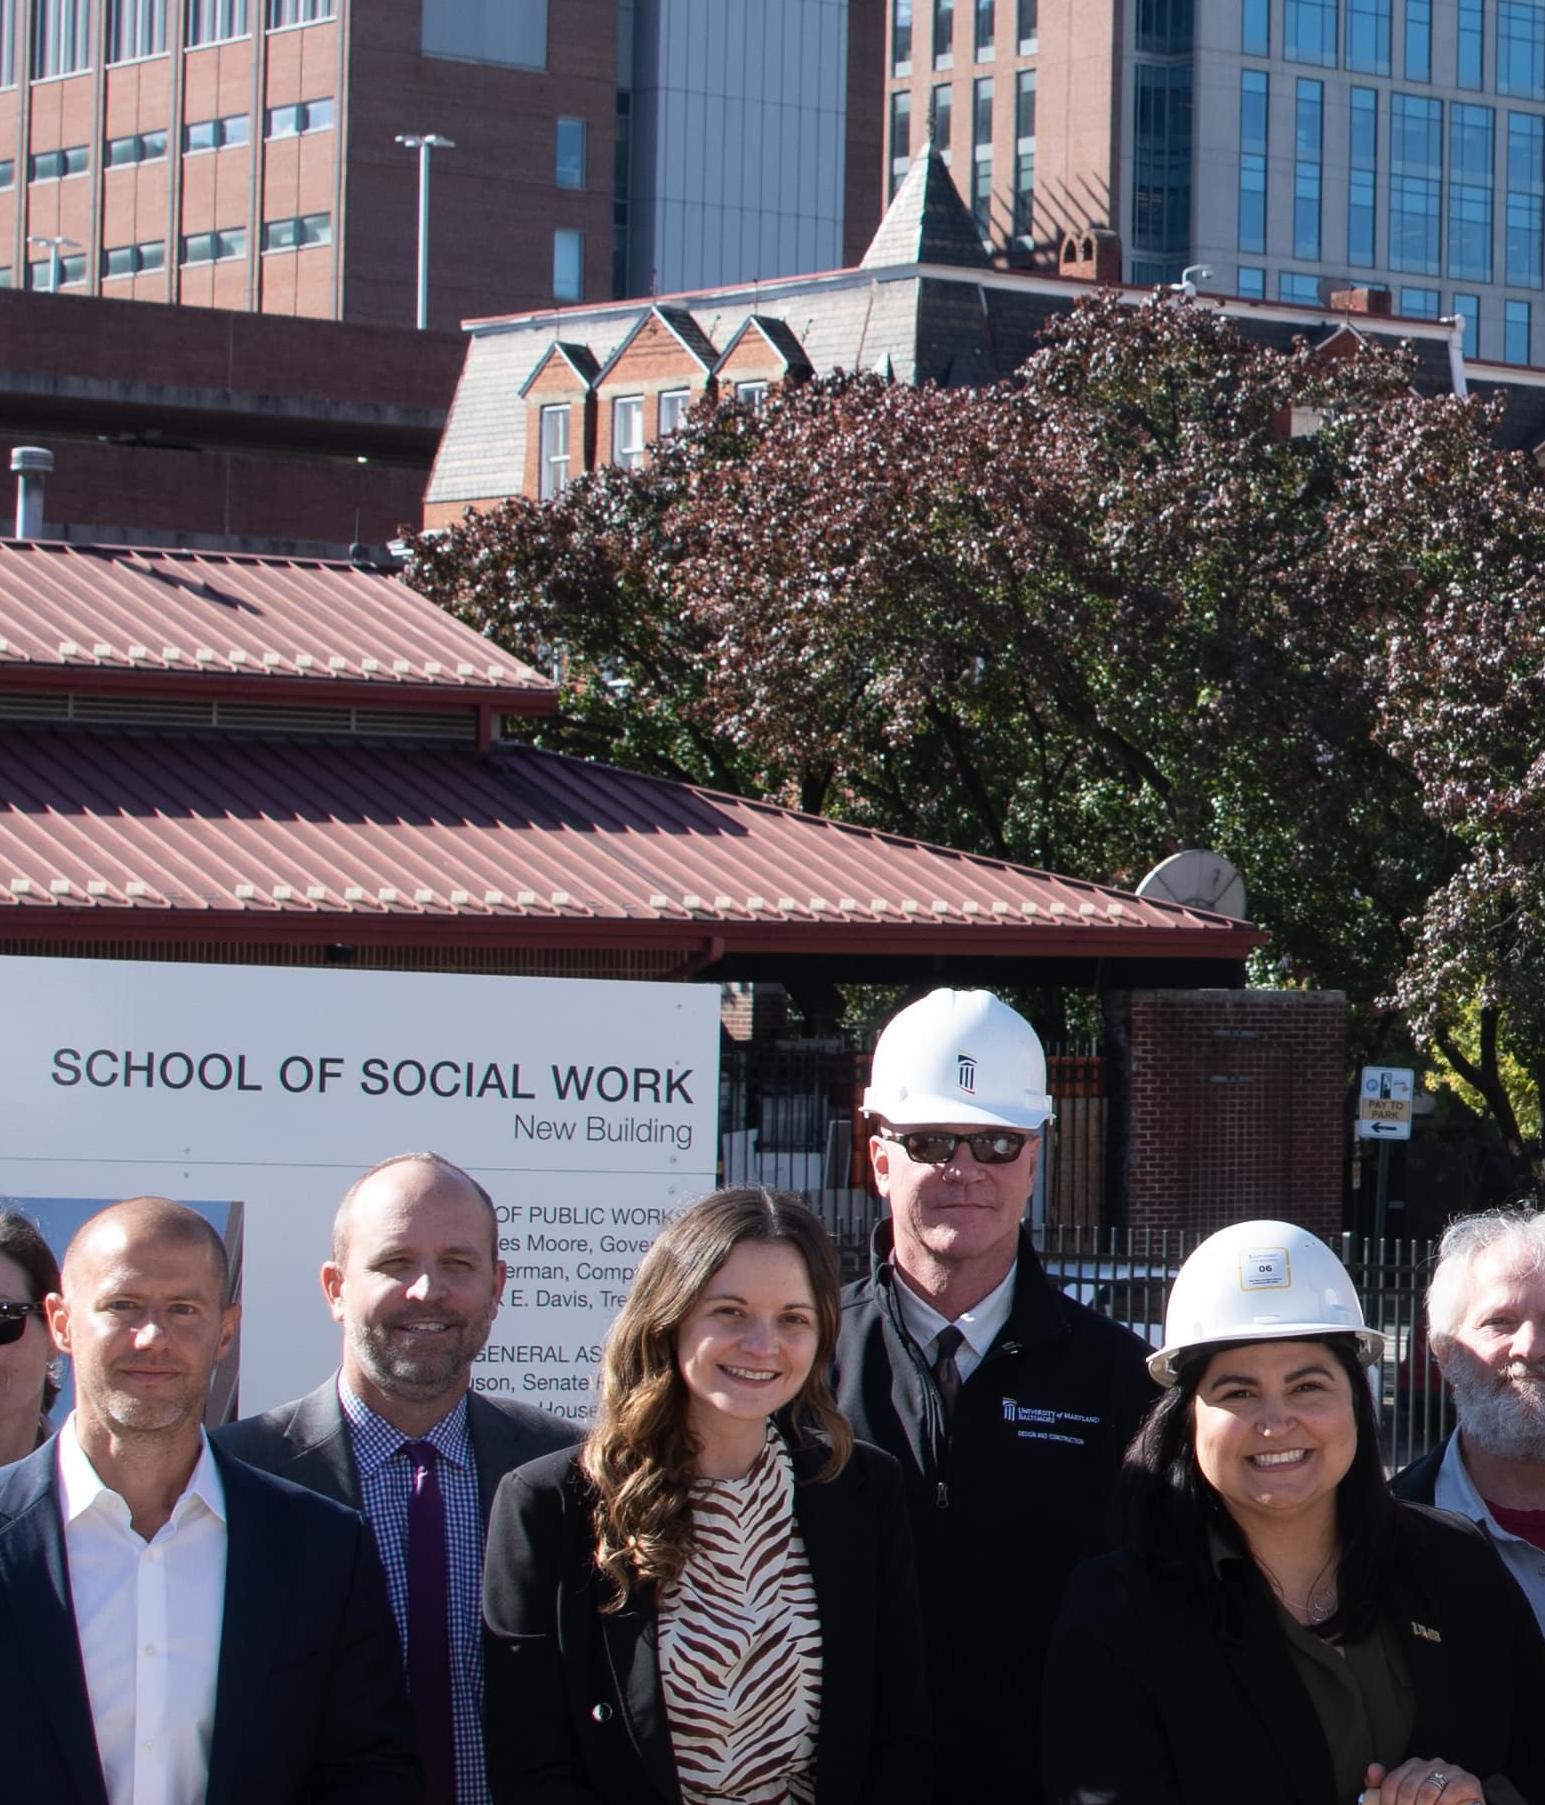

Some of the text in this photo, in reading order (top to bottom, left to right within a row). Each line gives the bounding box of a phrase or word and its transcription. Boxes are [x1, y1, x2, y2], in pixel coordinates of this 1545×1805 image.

[51, 1048, 695, 1104] SCHOOL OF SOCIAL WORK
[1368, 1100, 1404, 1110] PAY TO
[1371, 1110, 1399, 1119] PARK
[513, 1114, 694, 1150] New Building
[497, 1206, 523, 1223] OF
[529, 1207, 605, 1225] PUBLIC
[527, 1235, 593, 1255] Moore,
[1258, 1264, 1273, 1273] 06
[511, 1290, 529, 1306] E.
[536, 1290, 594, 1309] Davis,
[473, 1346, 569, 1363] GENERAL
[523, 1373, 589, 1391] Senate
